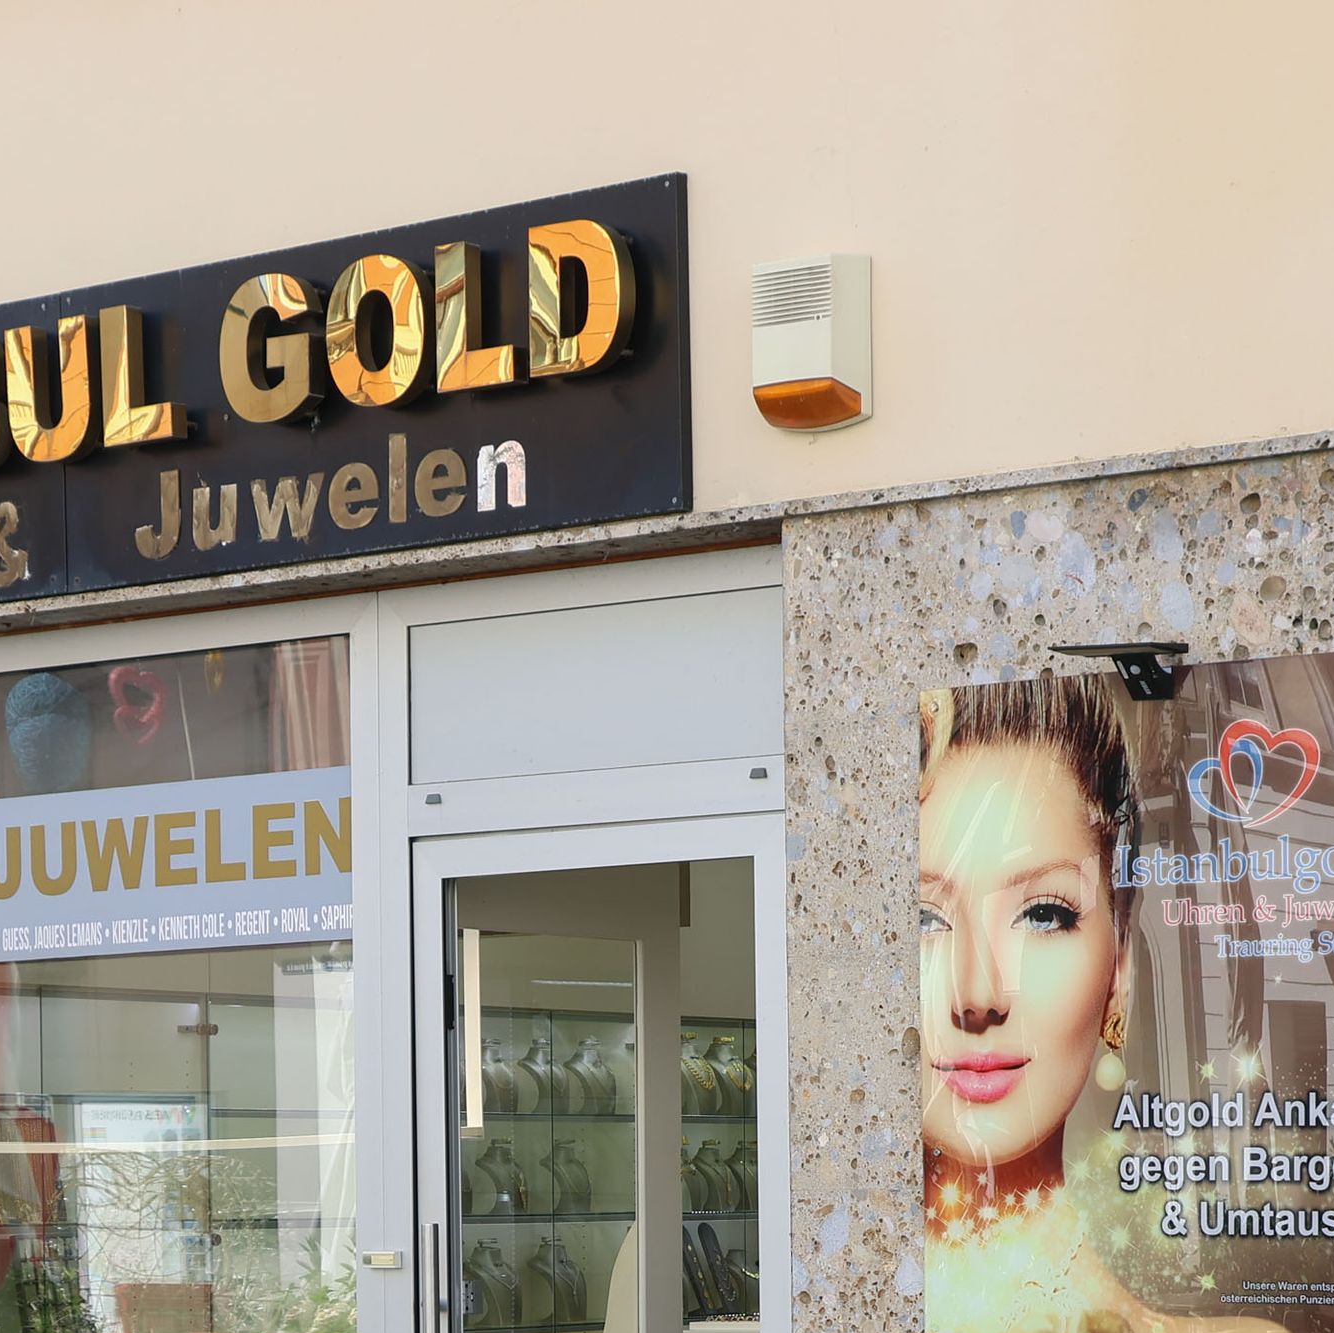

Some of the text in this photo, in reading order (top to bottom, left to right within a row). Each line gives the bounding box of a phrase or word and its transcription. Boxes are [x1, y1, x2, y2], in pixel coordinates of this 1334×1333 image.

[220, 219, 635, 425] GOLD
[134, 432, 528, 559] Juwelen
[1162, 896, 1246, 926] Uhren
[1252, 895, 1276, 923] &
[2, 927, 32, 952] GUESS,
[33, 924, 66, 949] JAQUES
[67, 921, 102, 947] LEMANS
[112, 918, 149, 944] KIENZLE
[158, 915, 201, 941] KENNETH
[202, 912, 225, 938] COLE
[235, 909, 271, 936] REGENT
[281, 906, 311, 933] ROYAL
[1214, 933, 1313, 963] Trauring
[1113, 1092, 1244, 1136] Altgold
[1119, 1153, 1229, 1190] gegen
[1161, 1200, 1187, 1236] &
[1220, 1294, 1298, 1304] österreichischen
[1242, 1281, 1276, 1291] Unsere
[1278, 1281, 1308, 1291] Waren
